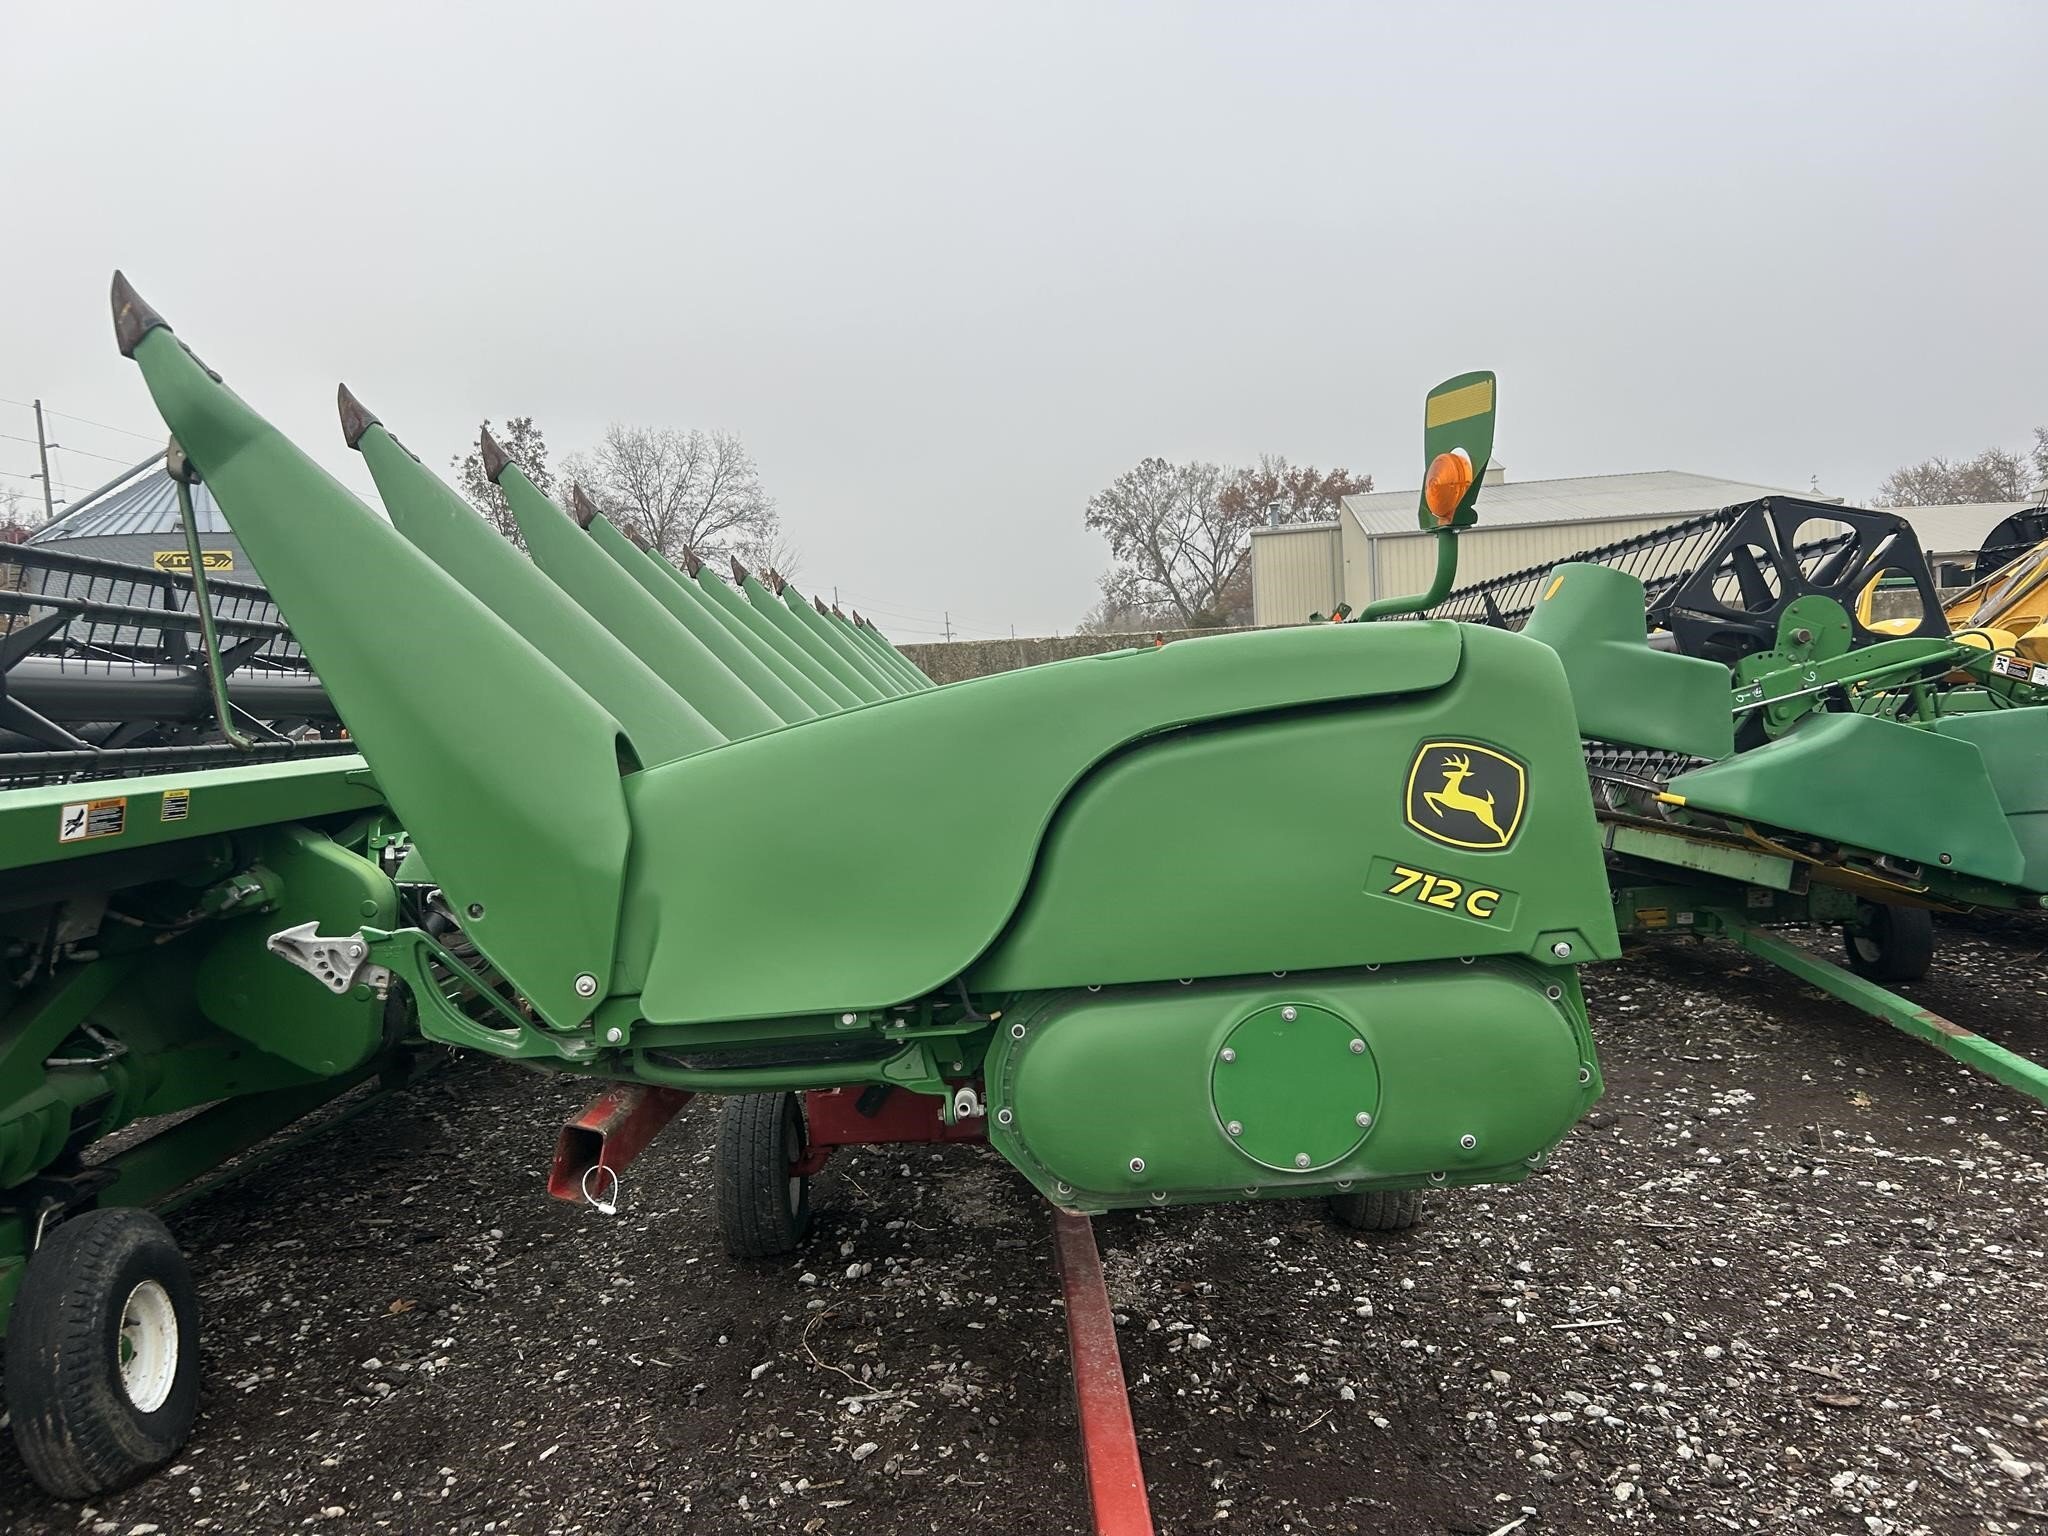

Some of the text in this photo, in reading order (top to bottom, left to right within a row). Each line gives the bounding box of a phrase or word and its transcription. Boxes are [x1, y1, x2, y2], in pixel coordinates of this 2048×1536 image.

[172, 556, 216, 566] ms
[1386, 865, 1502, 918] 712 C
